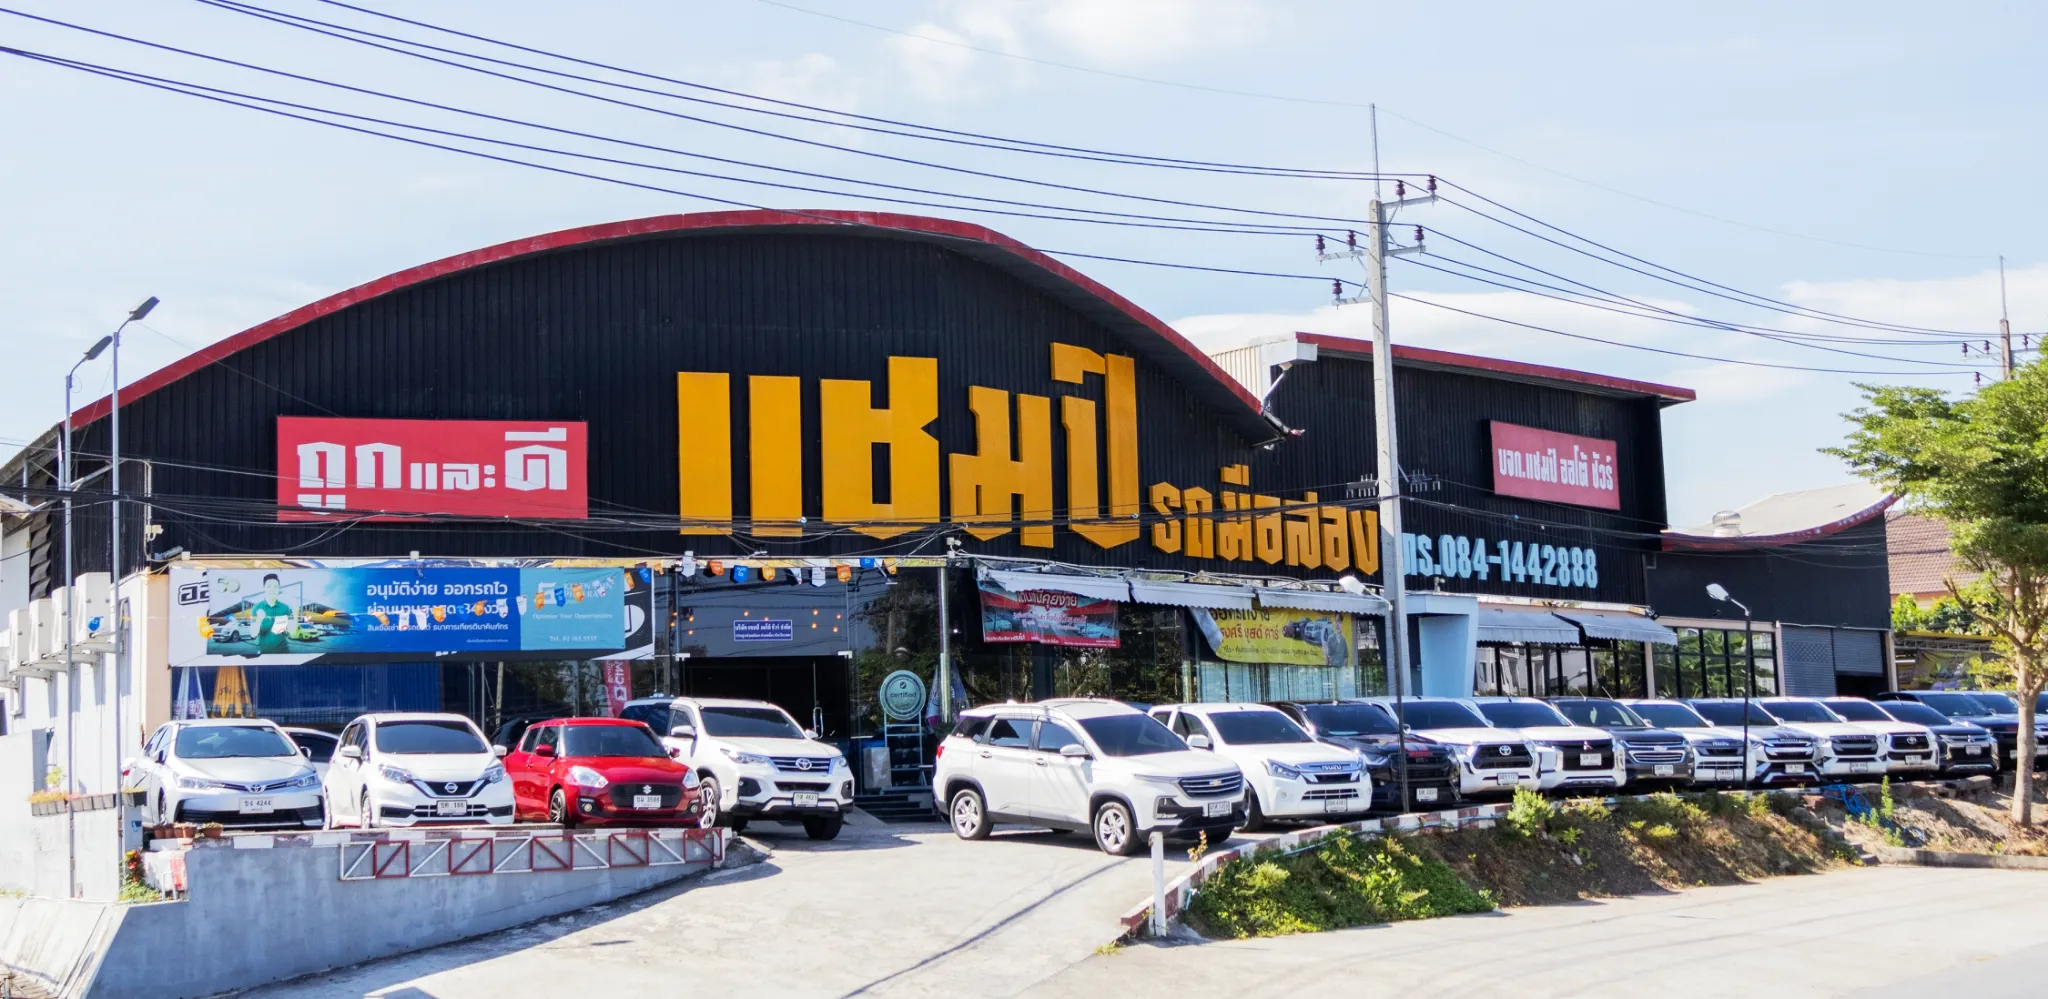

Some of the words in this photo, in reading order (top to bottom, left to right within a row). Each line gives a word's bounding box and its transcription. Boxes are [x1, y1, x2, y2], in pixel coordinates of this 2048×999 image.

[297, 427, 567, 515] ถูกและดี
[1560, 445, 1588, 487] ออโต้
[1592, 451, 1614, 491] ชัวร์
[1149, 463, 1378, 575] รถมือสอง
[1402, 532, 1597, 588] ทร.084-1442888
[367, 580, 437, 600] อนุมัติง่าย
[444, 582, 508, 595] ออกรถไว
